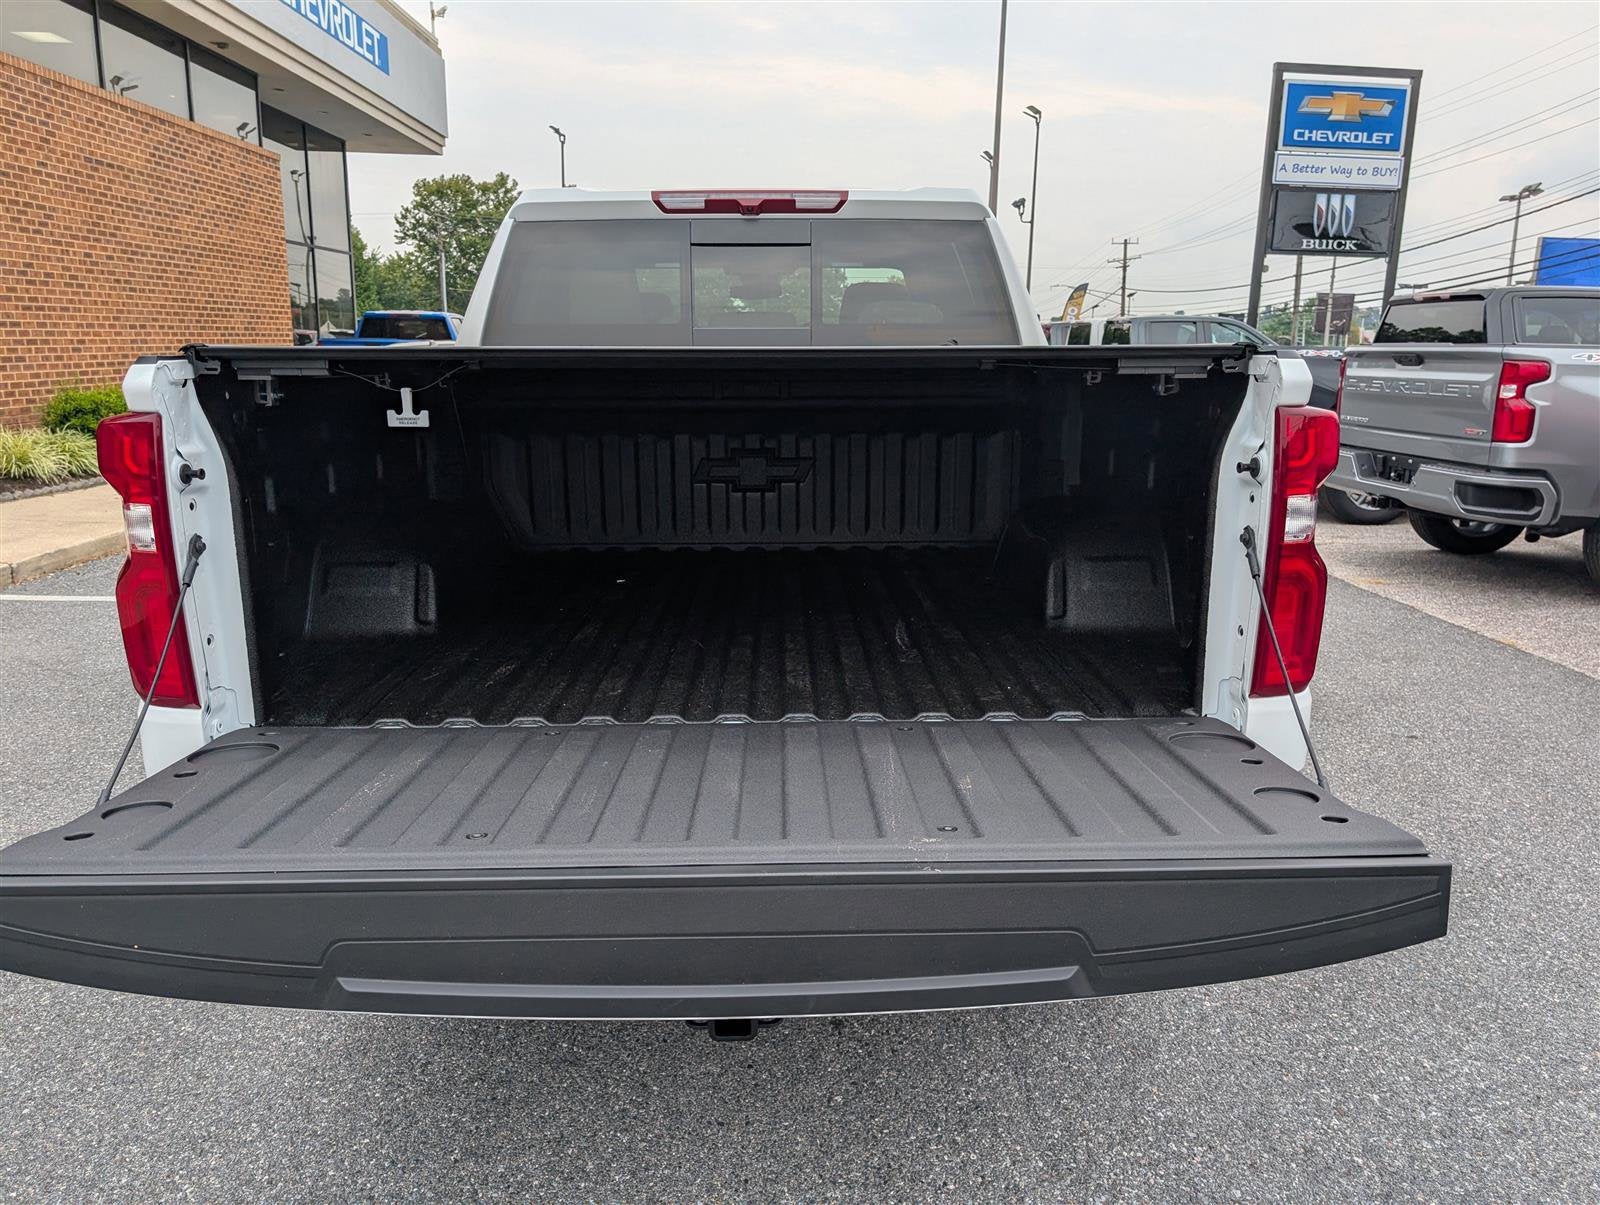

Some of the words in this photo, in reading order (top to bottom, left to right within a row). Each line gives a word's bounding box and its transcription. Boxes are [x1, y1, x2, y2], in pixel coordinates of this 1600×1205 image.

[281, 0, 380, 66] EVROLET
[1293, 129, 1394, 145] CHEVROLET
[1279, 163, 1288, 173] A
[1292, 163, 1327, 174] Better
[1330, 165, 1352, 179] Way
[1357, 167, 1368, 176] to
[1371, 167, 1399, 177] BUY!
[1300, 238, 1359, 251] BUICK
[1346, 379, 1480, 397] CHEVROLET
